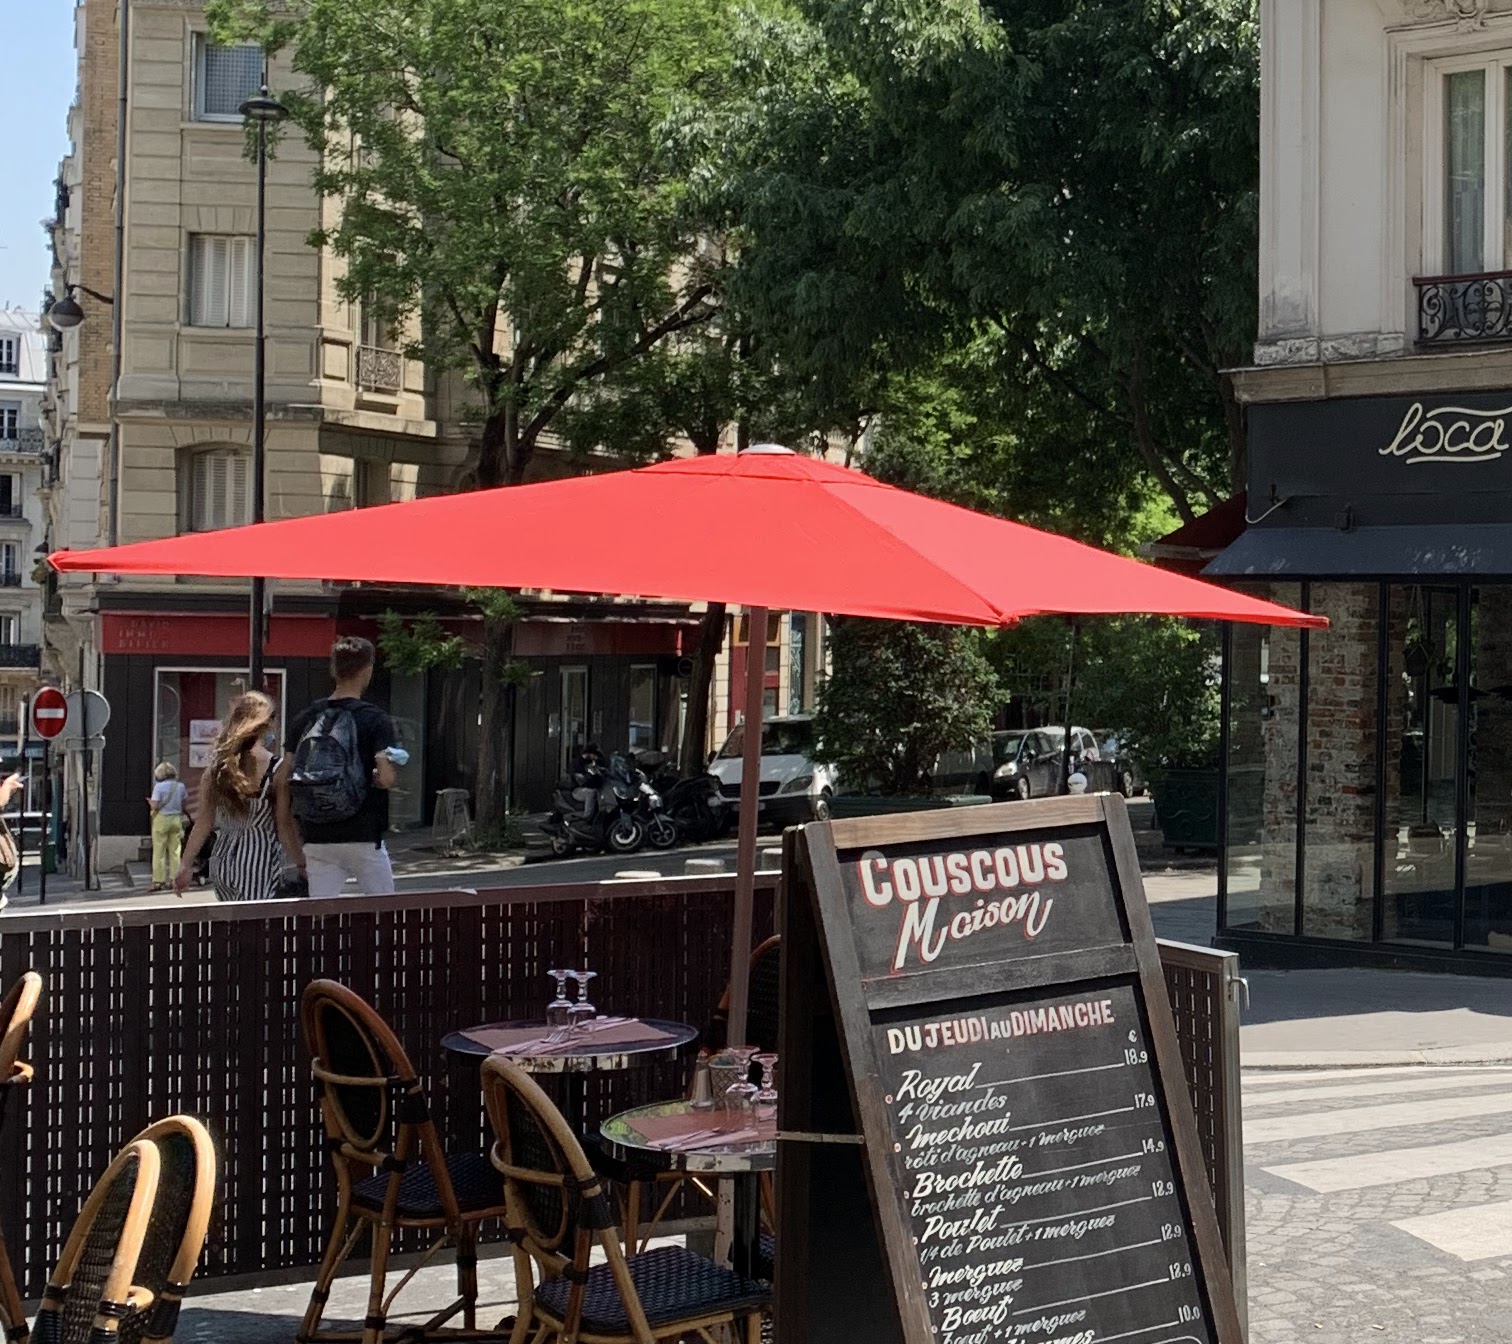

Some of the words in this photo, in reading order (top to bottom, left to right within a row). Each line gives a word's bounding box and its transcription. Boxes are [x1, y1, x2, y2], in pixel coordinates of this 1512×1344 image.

[858, 842, 1068, 907] COUSCOUS
[892, 891, 1054, 971] Maison
[887, 1025, 923, 1055] DU
[924, 1017, 990, 1048] JEUDI
[990, 1021, 1011, 1040] AU
[1011, 1000, 1115, 1037] DIMANCHE
[896, 1062, 982, 1103] Royal
[1124, 1048, 1148, 1066] 18.9
[898, 1103, 913, 1124] 4
[1134, 1093, 1155, 1108] 17.9
[904, 1146, 941, 1170] rôti
[912, 1155, 1023, 1198] Brochette
[1142, 1138, 1165, 1154] 14.9
[911, 1188, 982, 1216] brochette
[921, 1205, 1006, 1243] Poulet
[920, 1246, 940, 1265] 1/4
[940, 1239, 963, 1258] de
[929, 1292, 940, 1308] 3
[943, 1279, 1023, 1305] merguez
[1014, 1310, 1086, 1334] merguez
[1178, 1305, 1200, 1324] 10.0
